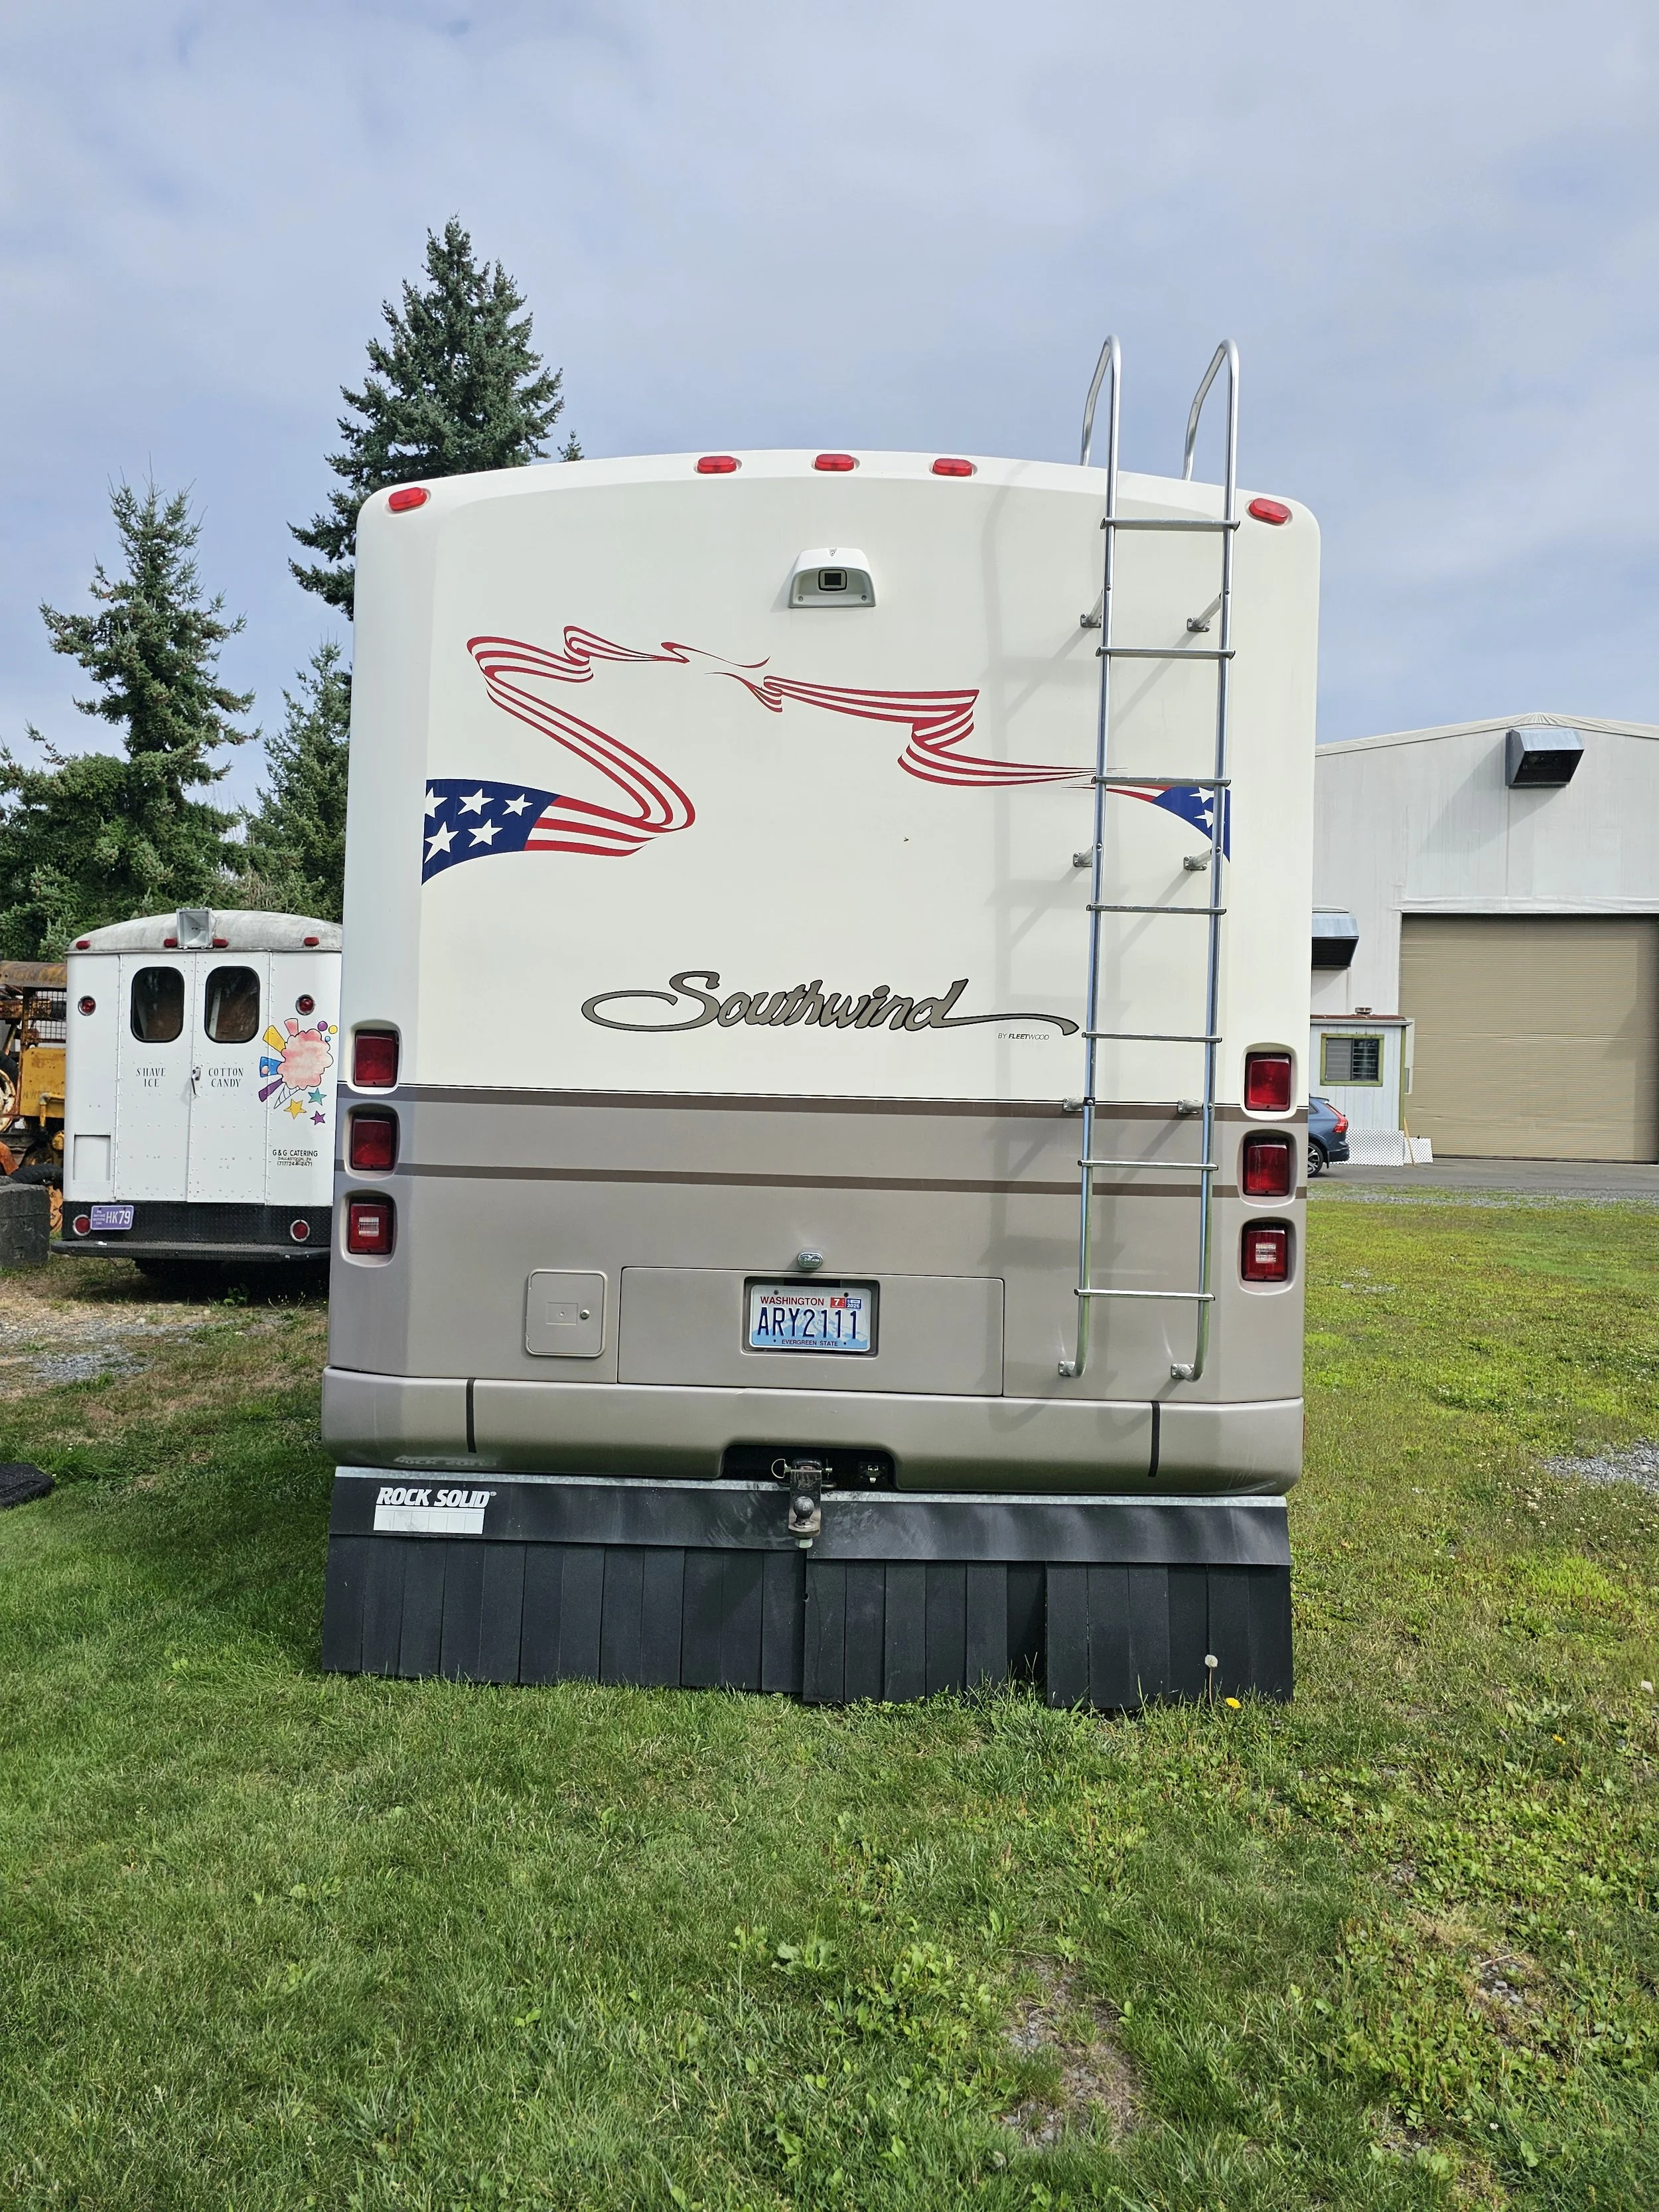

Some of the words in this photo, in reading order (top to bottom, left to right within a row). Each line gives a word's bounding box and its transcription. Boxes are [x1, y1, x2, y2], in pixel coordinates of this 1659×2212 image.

[581, 971, 1079, 1032] Southwind
[135, 1068, 166, 1076] SHAVE
[208, 1068, 244, 1076] COTTON
[144, 1078, 159, 1087] ICE
[211, 1078, 241, 1087] CANDY
[106, 1211, 131, 1224] HK79
[760, 1296, 824, 1306] WASHINGTON
[757, 1307, 856, 1339] ARY2111
[376, 1487, 432, 1507] ROCK
